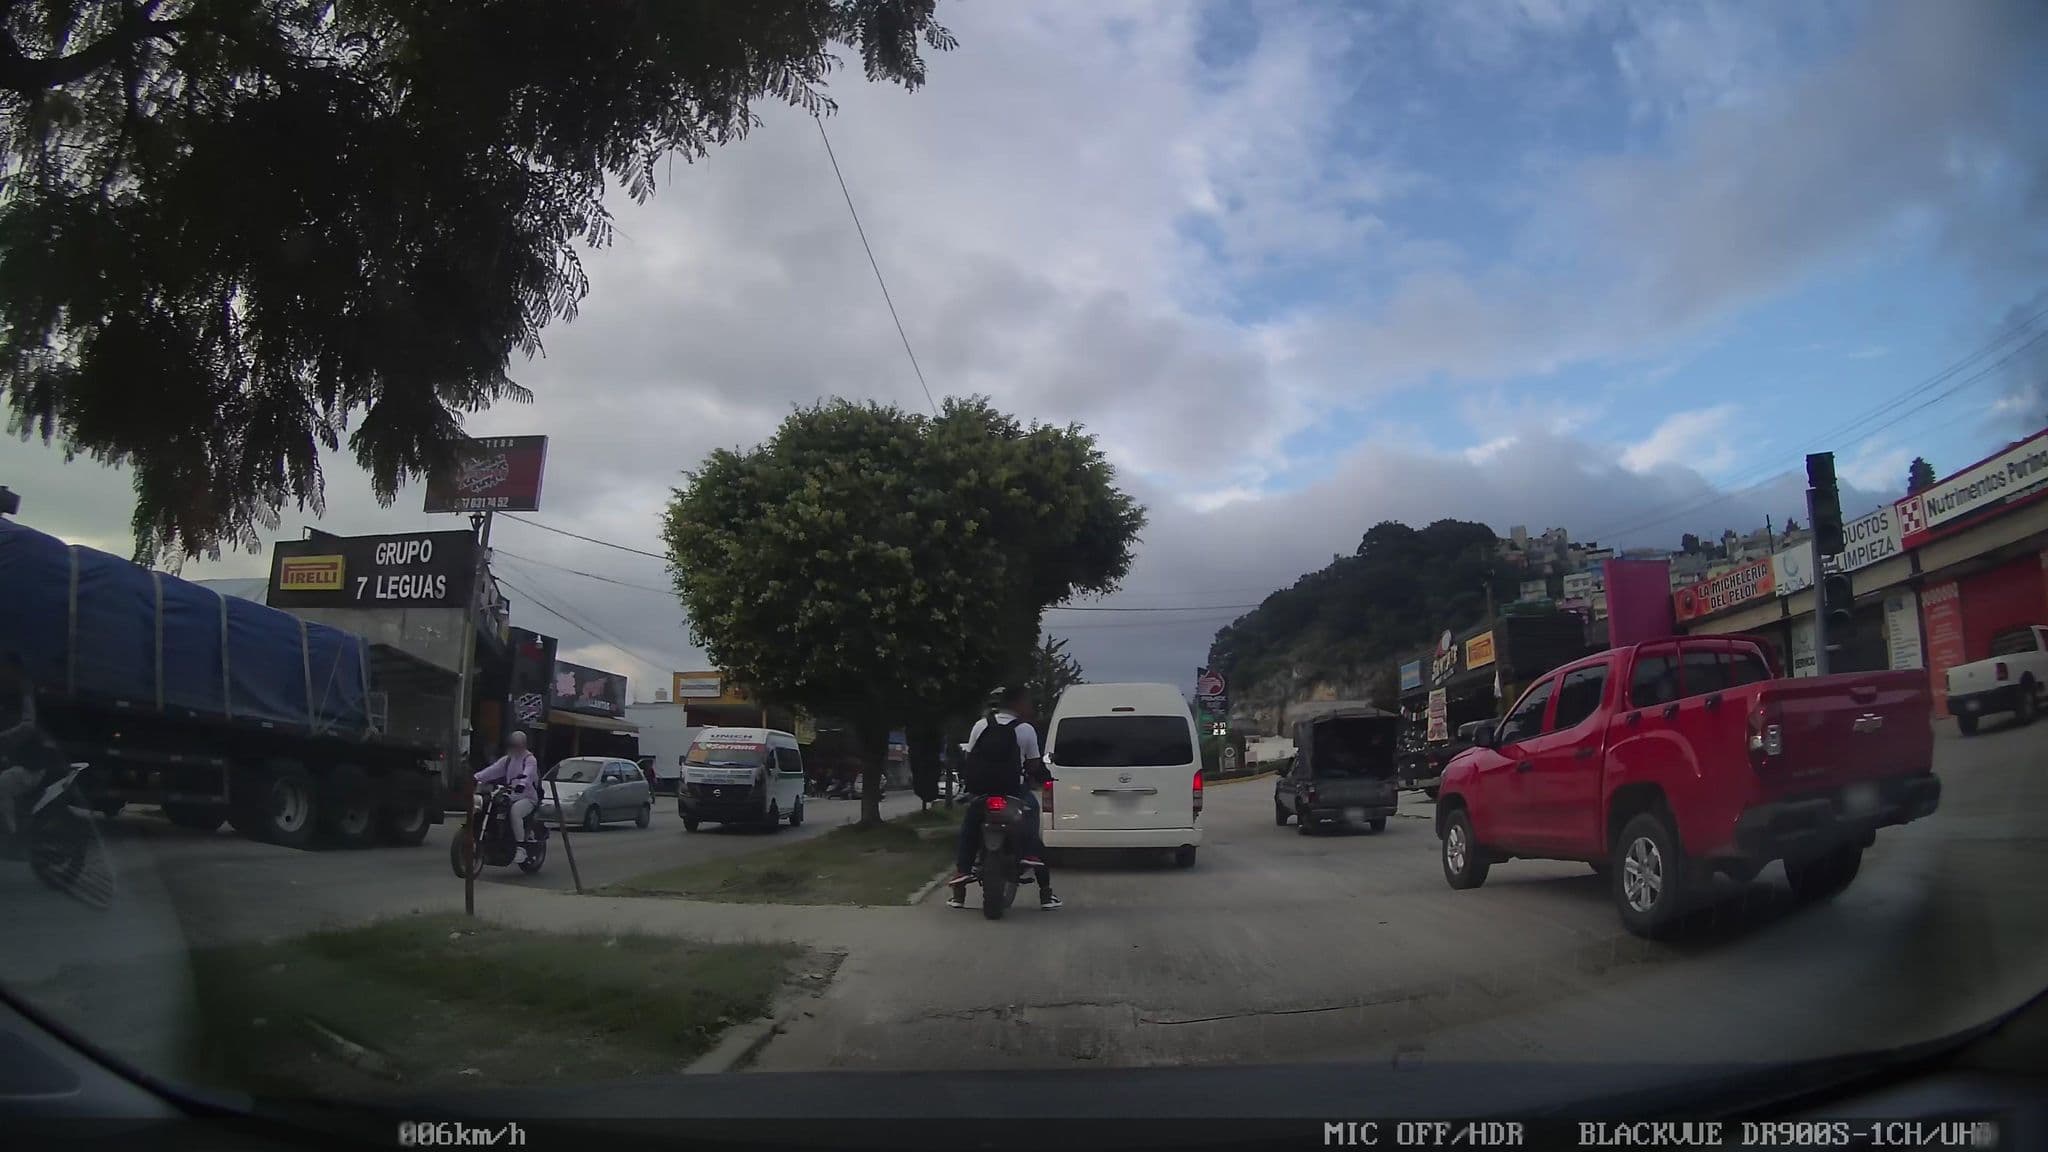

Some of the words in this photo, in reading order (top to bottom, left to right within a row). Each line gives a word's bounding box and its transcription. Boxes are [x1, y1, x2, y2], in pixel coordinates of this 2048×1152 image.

[1927, 471, 2006, 518] Nutrimentos
[2006, 450, 2048, 482] Purina
[1842, 513, 1889, 546] DUCTOS
[376, 539, 432, 565] GRUPO
[1836, 536, 1896, 571] LIMPIEZA
[282, 562, 337, 585] PIRELLI
[356, 576, 369, 600] 7
[376, 573, 447, 600] LEGUAS
[1697, 585, 1710, 599] LA
[1711, 563, 1768, 596] MICHELERIA
[1710, 594, 1727, 610] DEL
[1728, 582, 1758, 604] PELON
